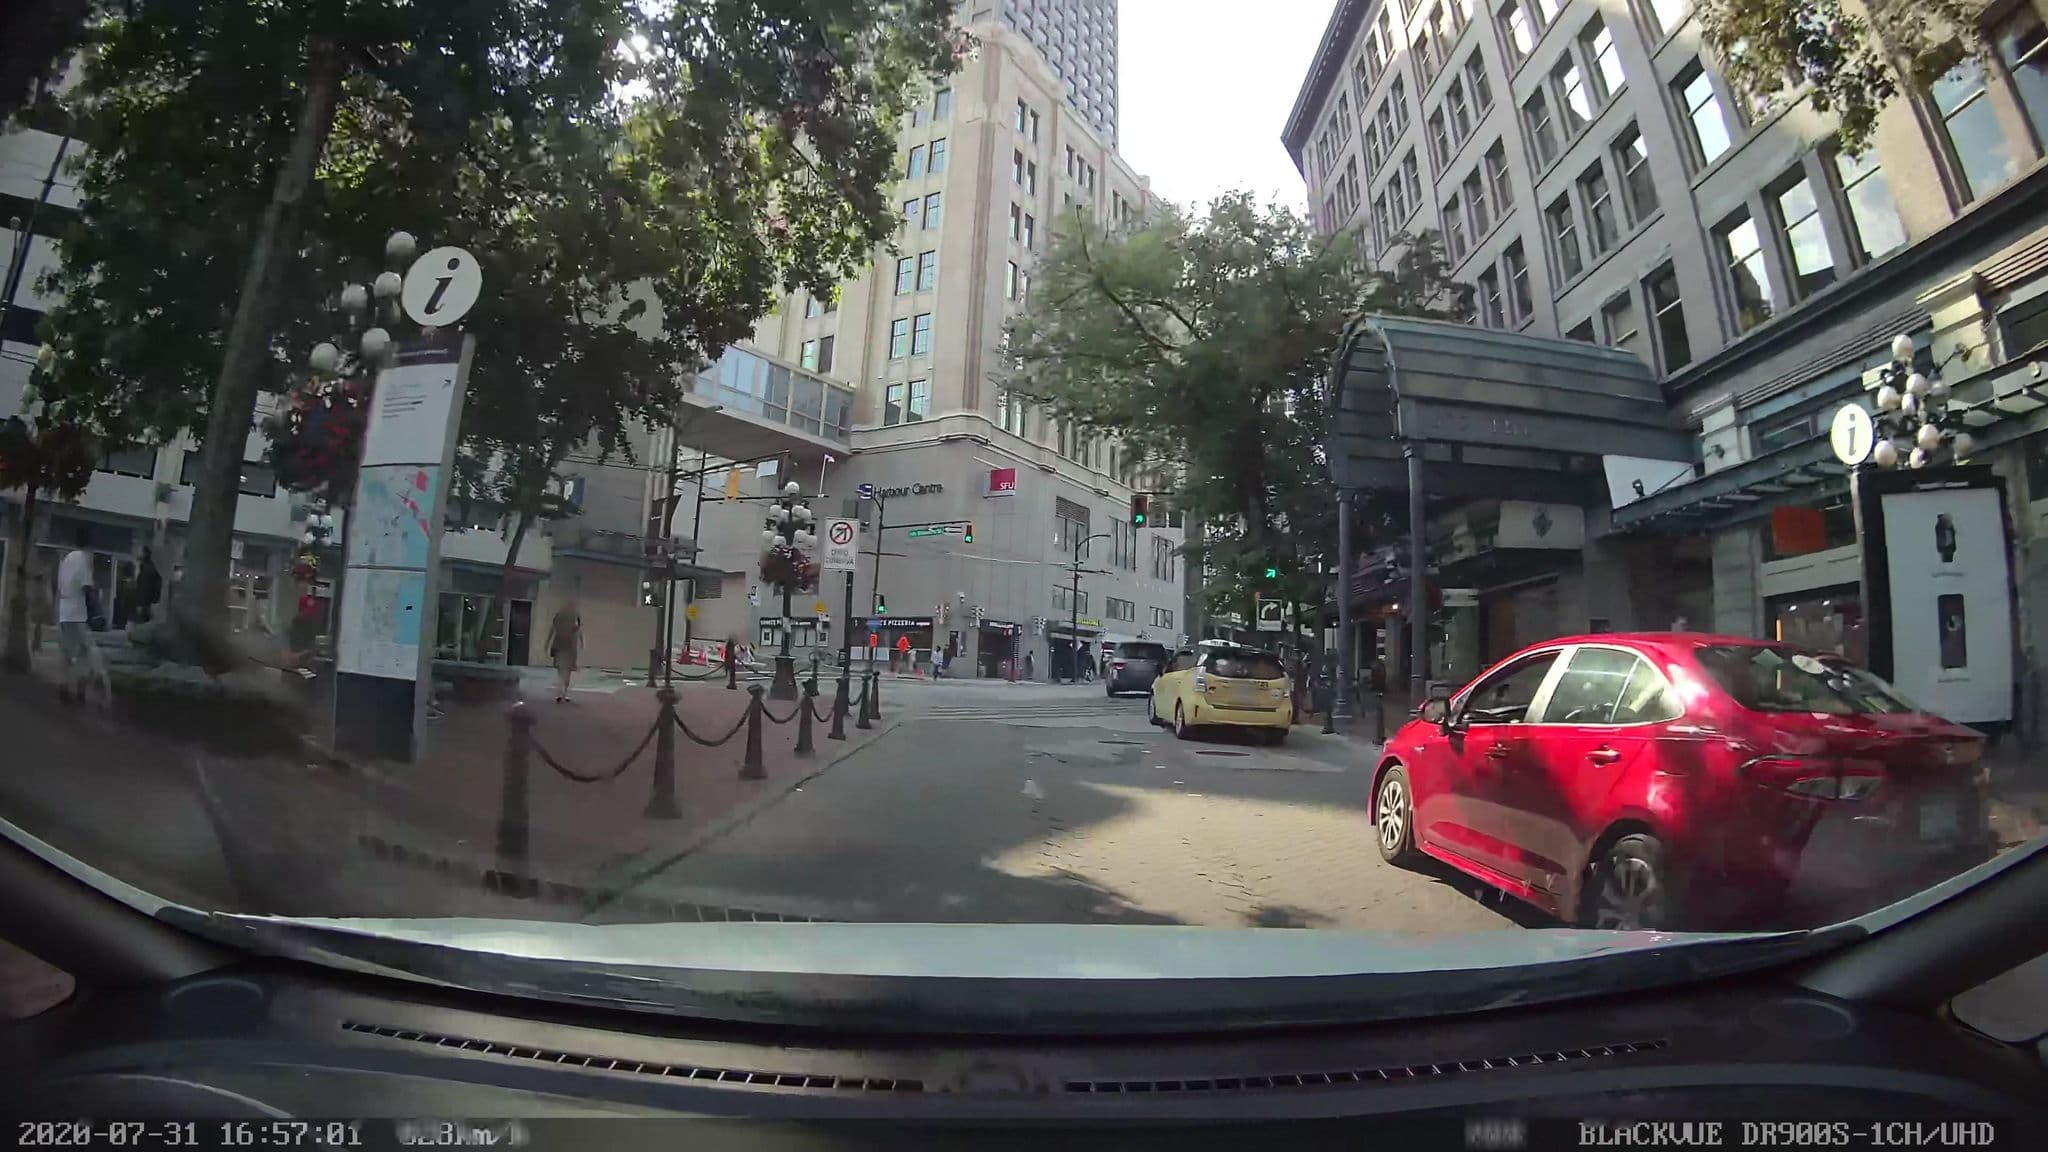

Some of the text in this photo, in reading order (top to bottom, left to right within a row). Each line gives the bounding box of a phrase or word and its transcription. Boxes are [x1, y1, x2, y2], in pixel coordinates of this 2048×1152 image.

[874, 482, 944, 499] Harbour Centre
[999, 481, 1014, 490] SFU
